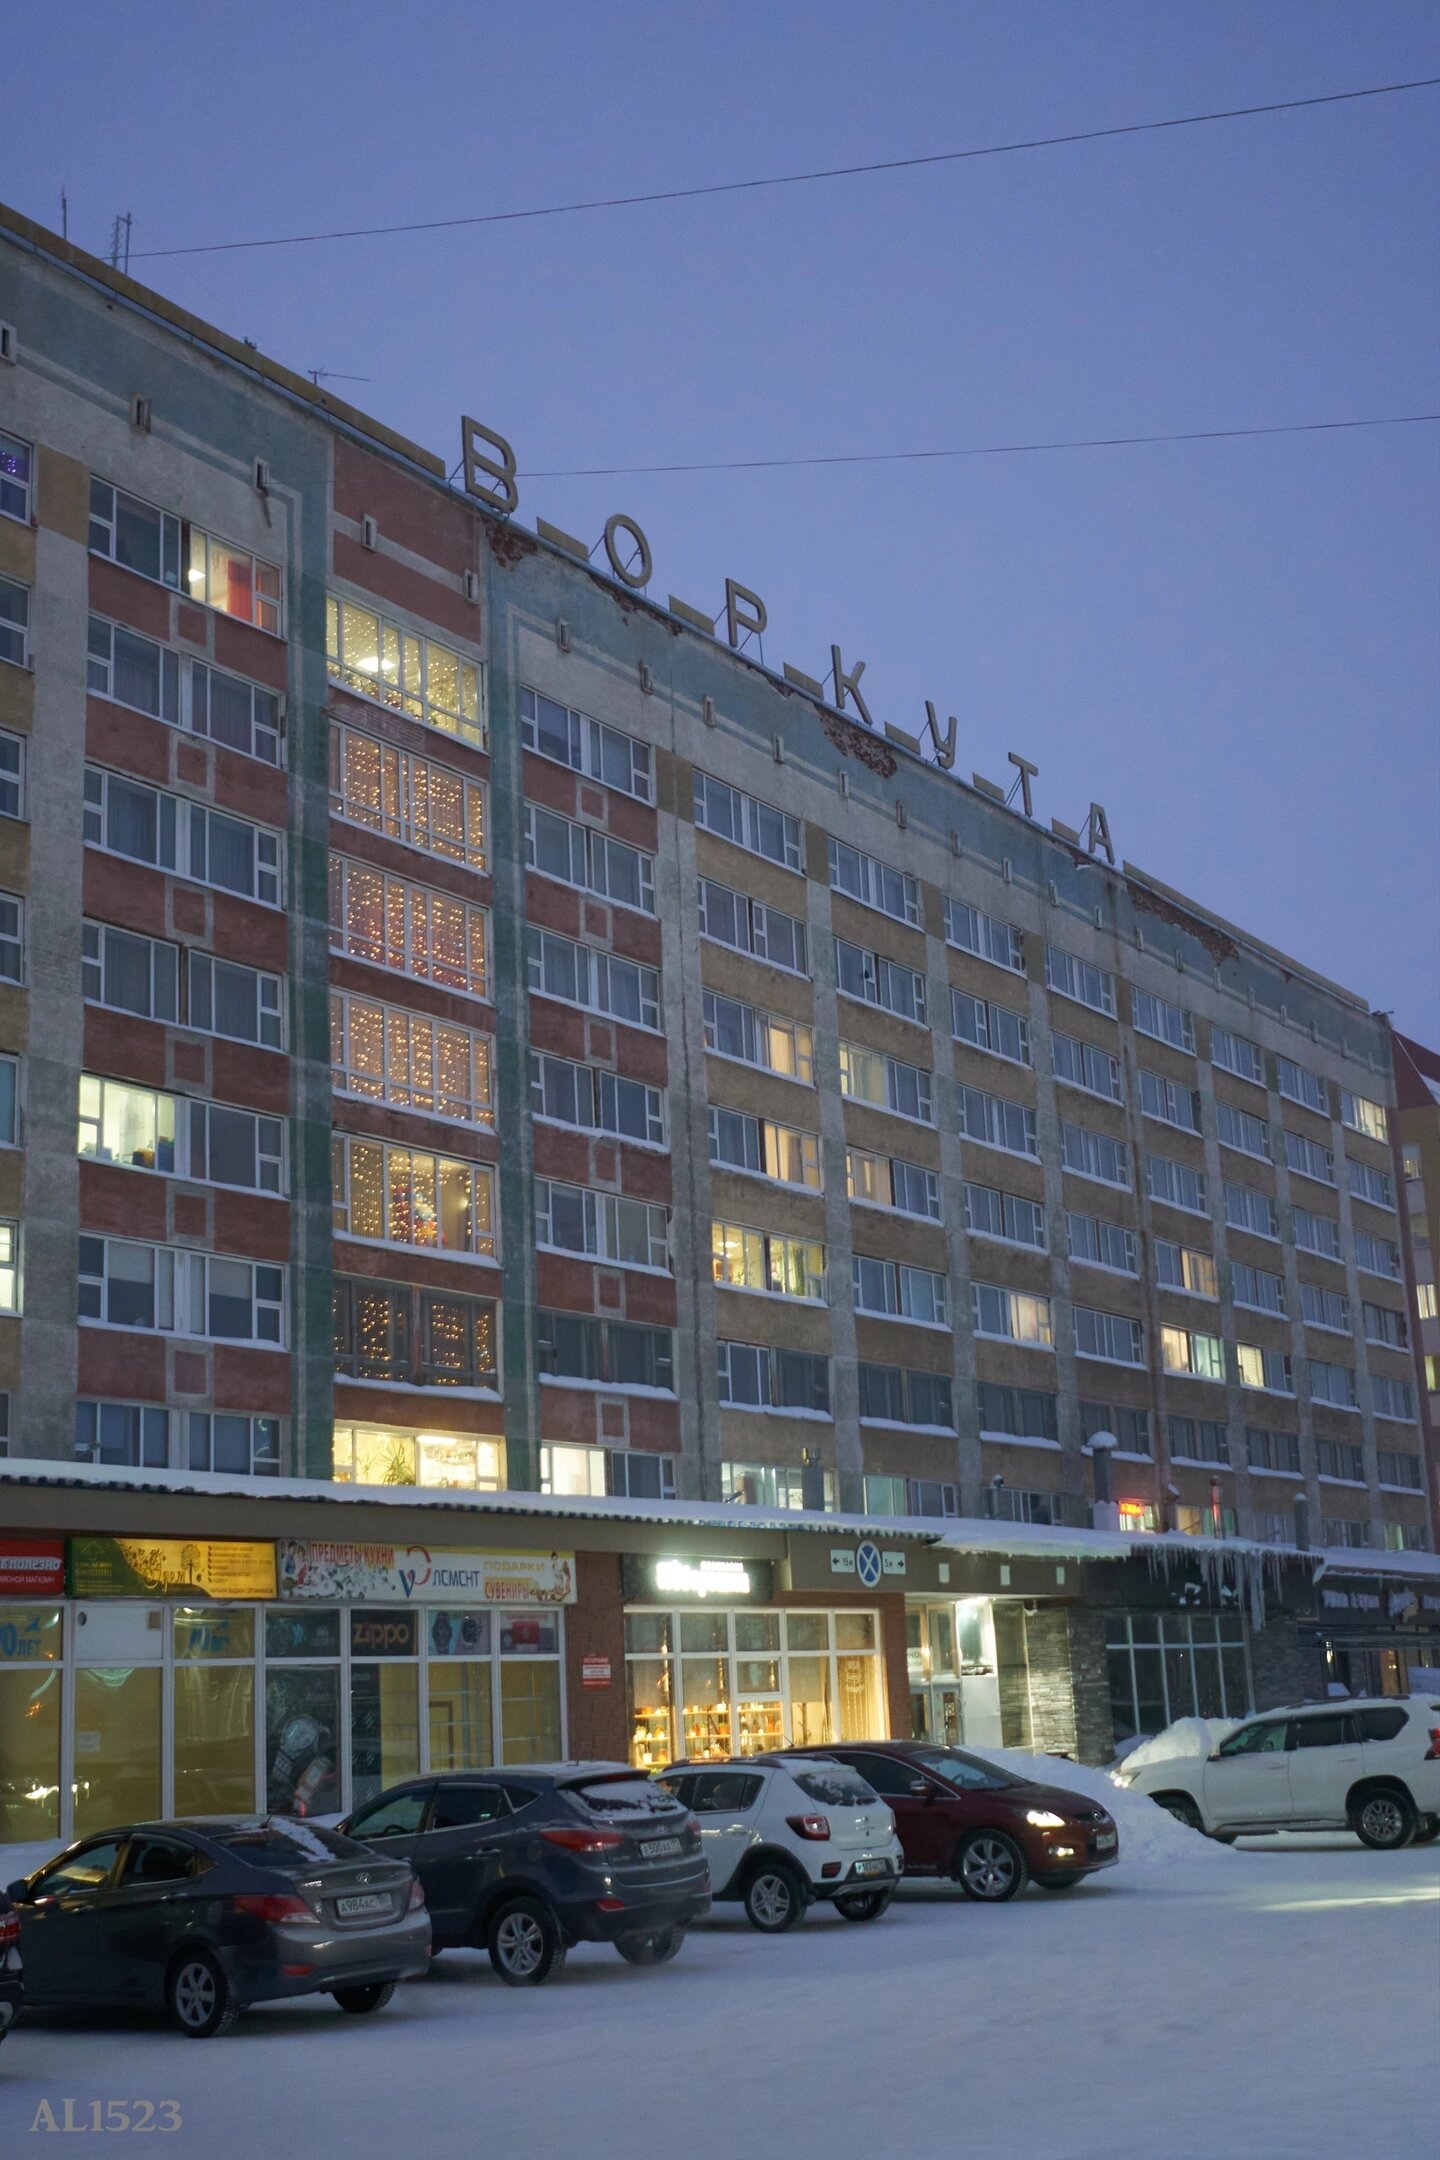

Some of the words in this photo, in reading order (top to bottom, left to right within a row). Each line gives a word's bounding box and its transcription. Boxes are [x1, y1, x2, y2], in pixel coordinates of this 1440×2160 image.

[461, 415, 1115, 866] ВОРКУТА
[311, 1543, 363, 1565] ПРЕДМЕТЫ
[364, 1545, 394, 1565] КУХНИ
[483, 1560, 546, 1572] ПОДАРКИ
[484, 1580, 531, 1600] СУВЕНИРЫ
[352, 1619, 410, 1649] zippo
